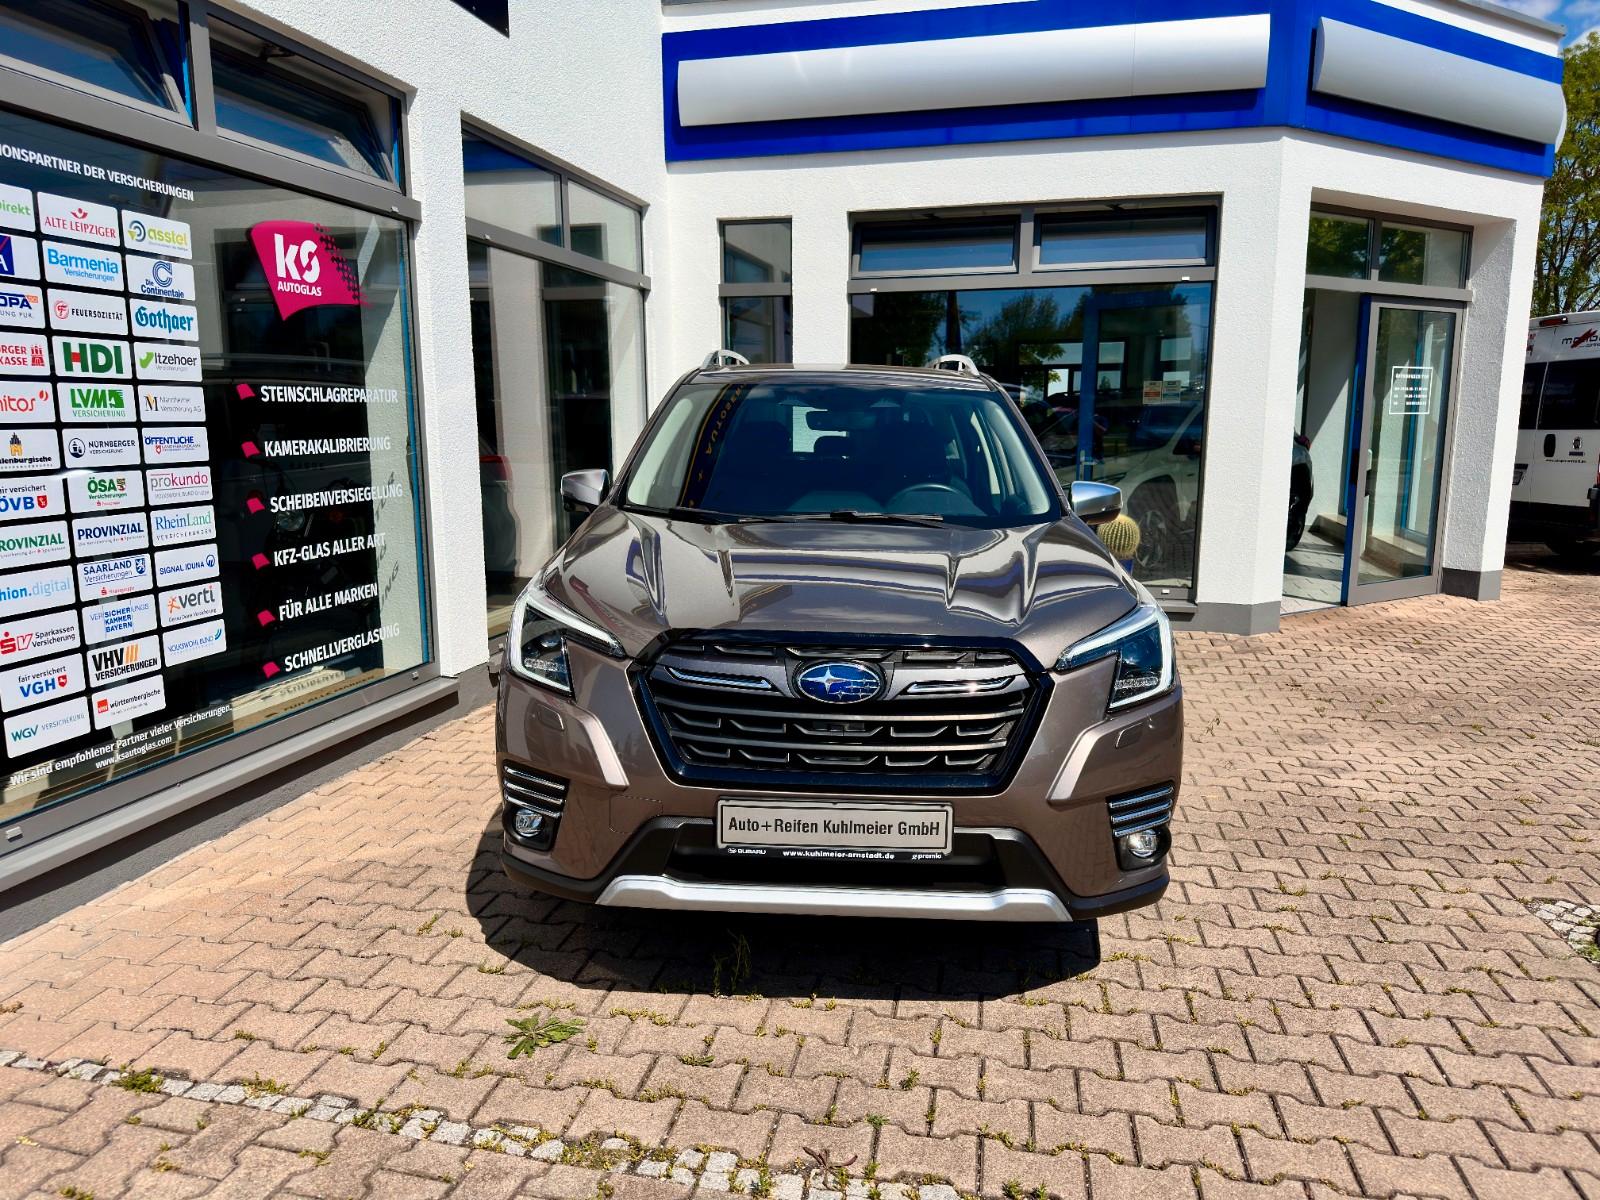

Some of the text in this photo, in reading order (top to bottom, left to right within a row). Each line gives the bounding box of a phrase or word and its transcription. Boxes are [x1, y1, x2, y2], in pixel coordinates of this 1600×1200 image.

[83, 164, 106, 180] DER
[107, 169, 195, 202] VERSICHERUNGEN
[44, 216, 117, 239] ALTE LEIPZIGER
[148, 226, 189, 246] asstel
[47, 248, 119, 274] Barmenia
[141, 284, 185, 299] Continentale
[277, 280, 323, 298] AUTOGLAS
[71, 308, 123, 321] FEUERSOZIETÄT
[135, 305, 194, 334] Gothaer
[62, 341, 124, 375] HDI
[155, 352, 198, 367] Itzehoer
[70, 388, 108, 409] LVM
[260, 385, 399, 404] STEINSCHLAGREPARATUR
[72, 409, 126, 418] VERSICHERUNG
[88, 439, 136, 449] NÜRNBERGER
[144, 435, 195, 445] ÖFFENTLICHE
[264, 436, 392, 457] KAMERAKALIBRIERUNG
[9, 484, 47, 494] versichert
[87, 476, 118, 494] ÖSA
[150, 471, 209, 492] prokundo
[0, 495, 35, 513] ÖVB
[270, 483, 403, 512] SCHEIBENVERSIEGELUNG
[155, 510, 212, 531] RheinLand
[77, 522, 145, 541] PROVINZIAL
[273, 532, 386, 567] KFZ-GLAS ALLER ART
[83, 560, 133, 576] SAARLAND
[159, 560, 205, 576] SIGNAL IDUNA
[178, 585, 215, 609] verti
[279, 599, 303, 622] FÜR
[304, 593, 333, 616] ALLE
[333, 582, 379, 608] MARKEN
[105, 613, 132, 626] KAMMER
[105, 622, 133, 633] BAYERN
[31, 633, 77, 649] Versicherung
[35, 626, 76, 640] Sparkassen
[284, 622, 401, 673] SCHNELLVERGLASUNG
[92, 647, 124, 672] VHV
[95, 658, 158, 682] VERSICHERUNGEN
[18, 665, 67, 684] fair versichert
[20, 677, 57, 699] VGH
[109, 688, 161, 709] württembergische
[11, 712, 86, 743] WGV VERSICHERUNG
[31, 762, 53, 779] sind
[54, 743, 115, 771] empfohlener
[116, 731, 150, 750] Partner
[149, 721, 174, 738] vieler
[95, 735, 172, 769] www.ksautoglas.com
[728, 816, 940, 837] Auto+Reifen Kuhlmeier GmbH
[782, 849, 896, 861] www.kuhlmeier-arnstadt.de
